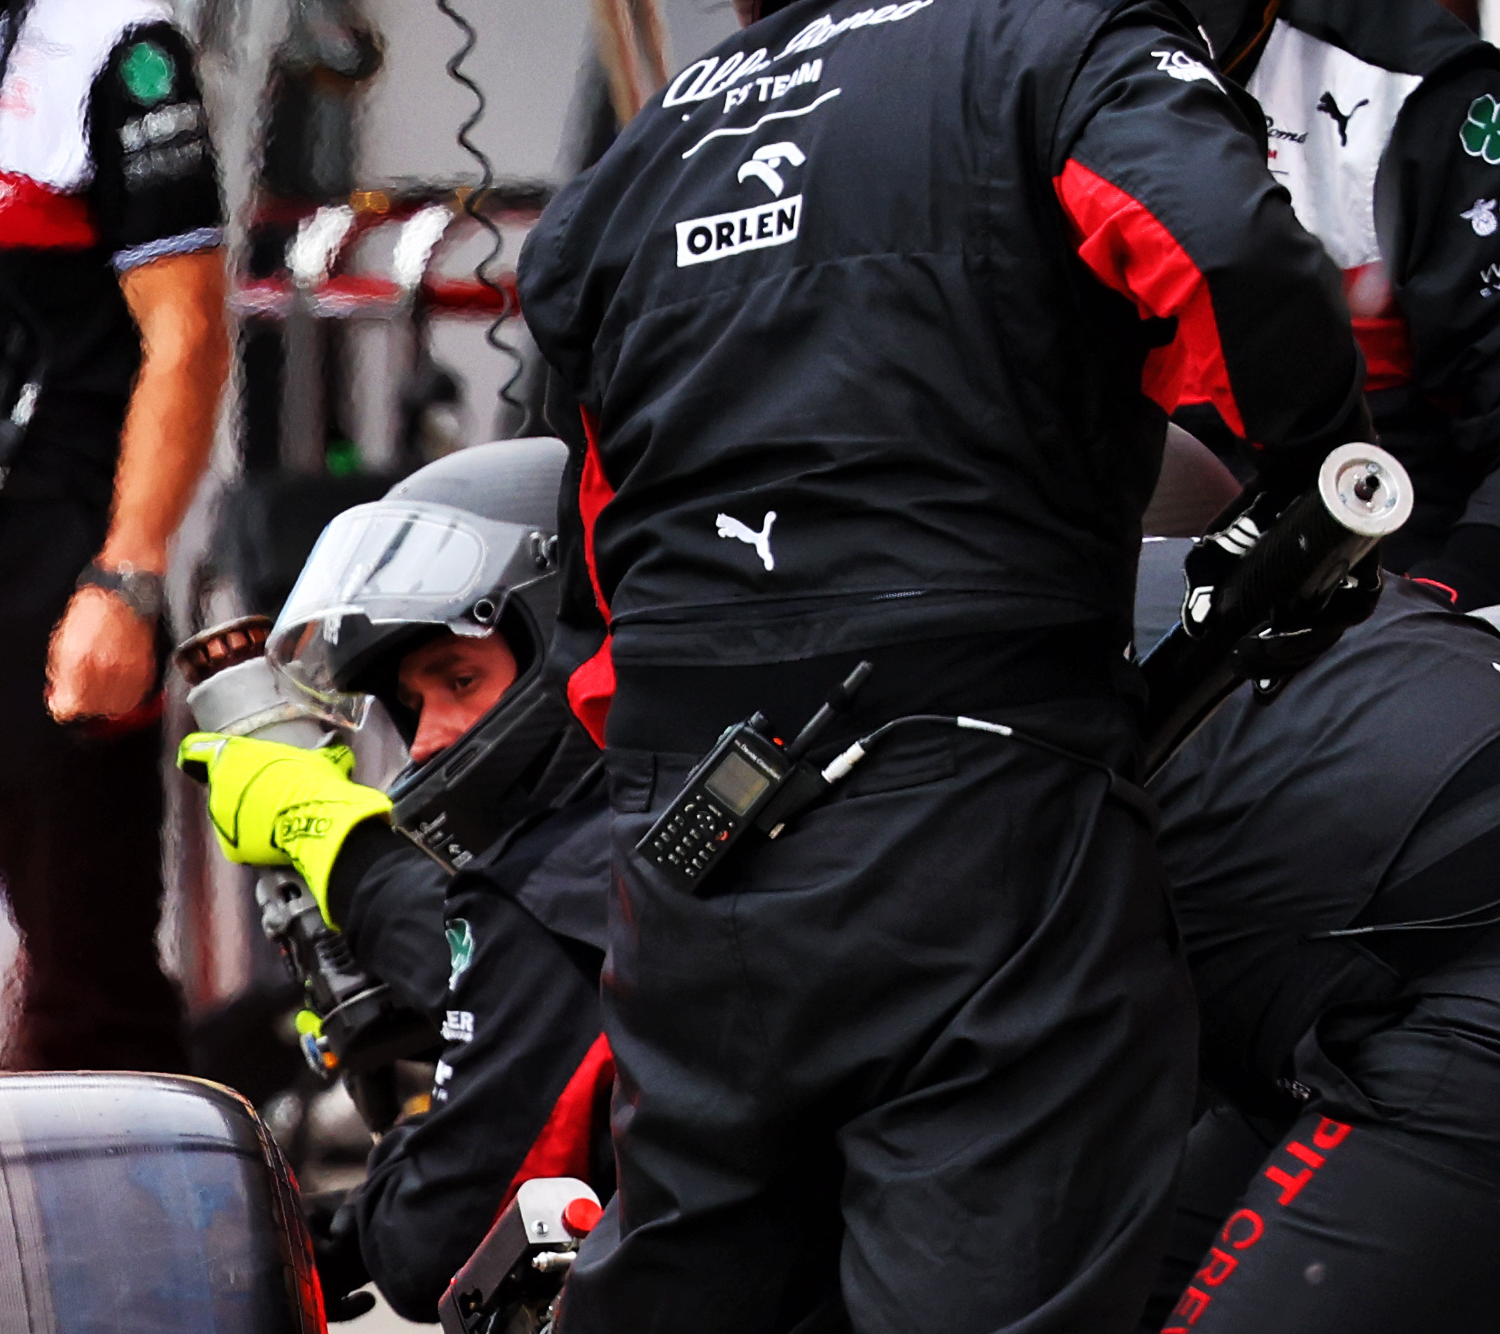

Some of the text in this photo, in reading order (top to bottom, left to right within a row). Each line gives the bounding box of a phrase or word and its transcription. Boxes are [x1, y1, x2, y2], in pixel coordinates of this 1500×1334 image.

[756, 59, 823, 102] TEAM
[686, 205, 796, 255] ORLEN
[1265, 1114, 1353, 1206] PIT
